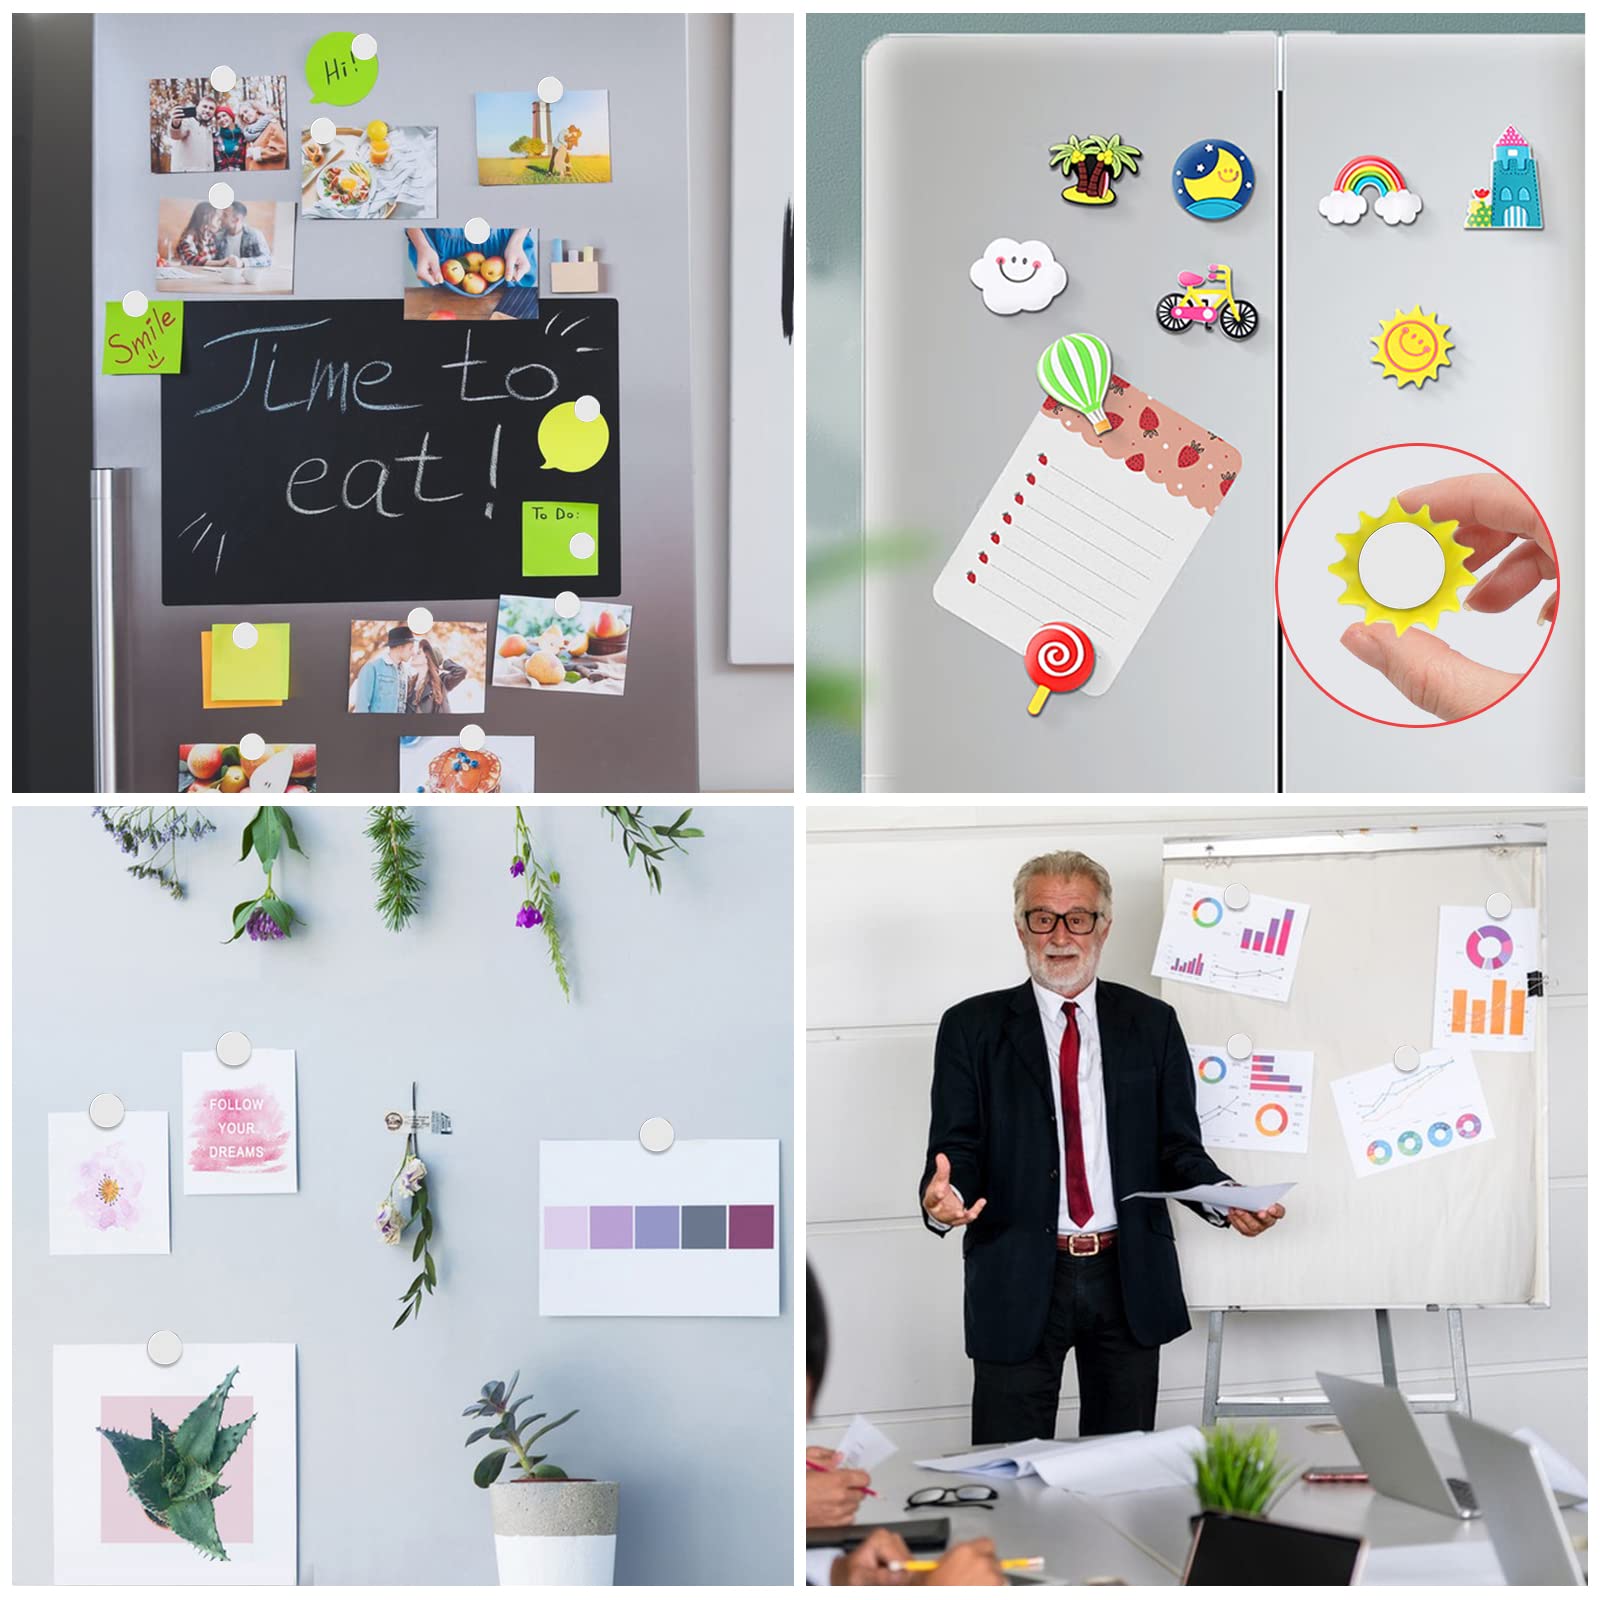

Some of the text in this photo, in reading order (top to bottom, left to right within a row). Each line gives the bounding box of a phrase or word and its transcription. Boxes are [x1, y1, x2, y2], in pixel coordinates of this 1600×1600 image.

[324, 50, 358, 86] Hi!
[108, 307, 176, 364] Smile
[194, 318, 560, 417] Time to
[286, 424, 502, 519] eat!
[531, 506, 580, 520] To Do:
[209, 1098, 264, 1111] FOLLOW
[218, 1122, 255, 1135] YOUR
[209, 1145, 264, 1158] DREAMS
